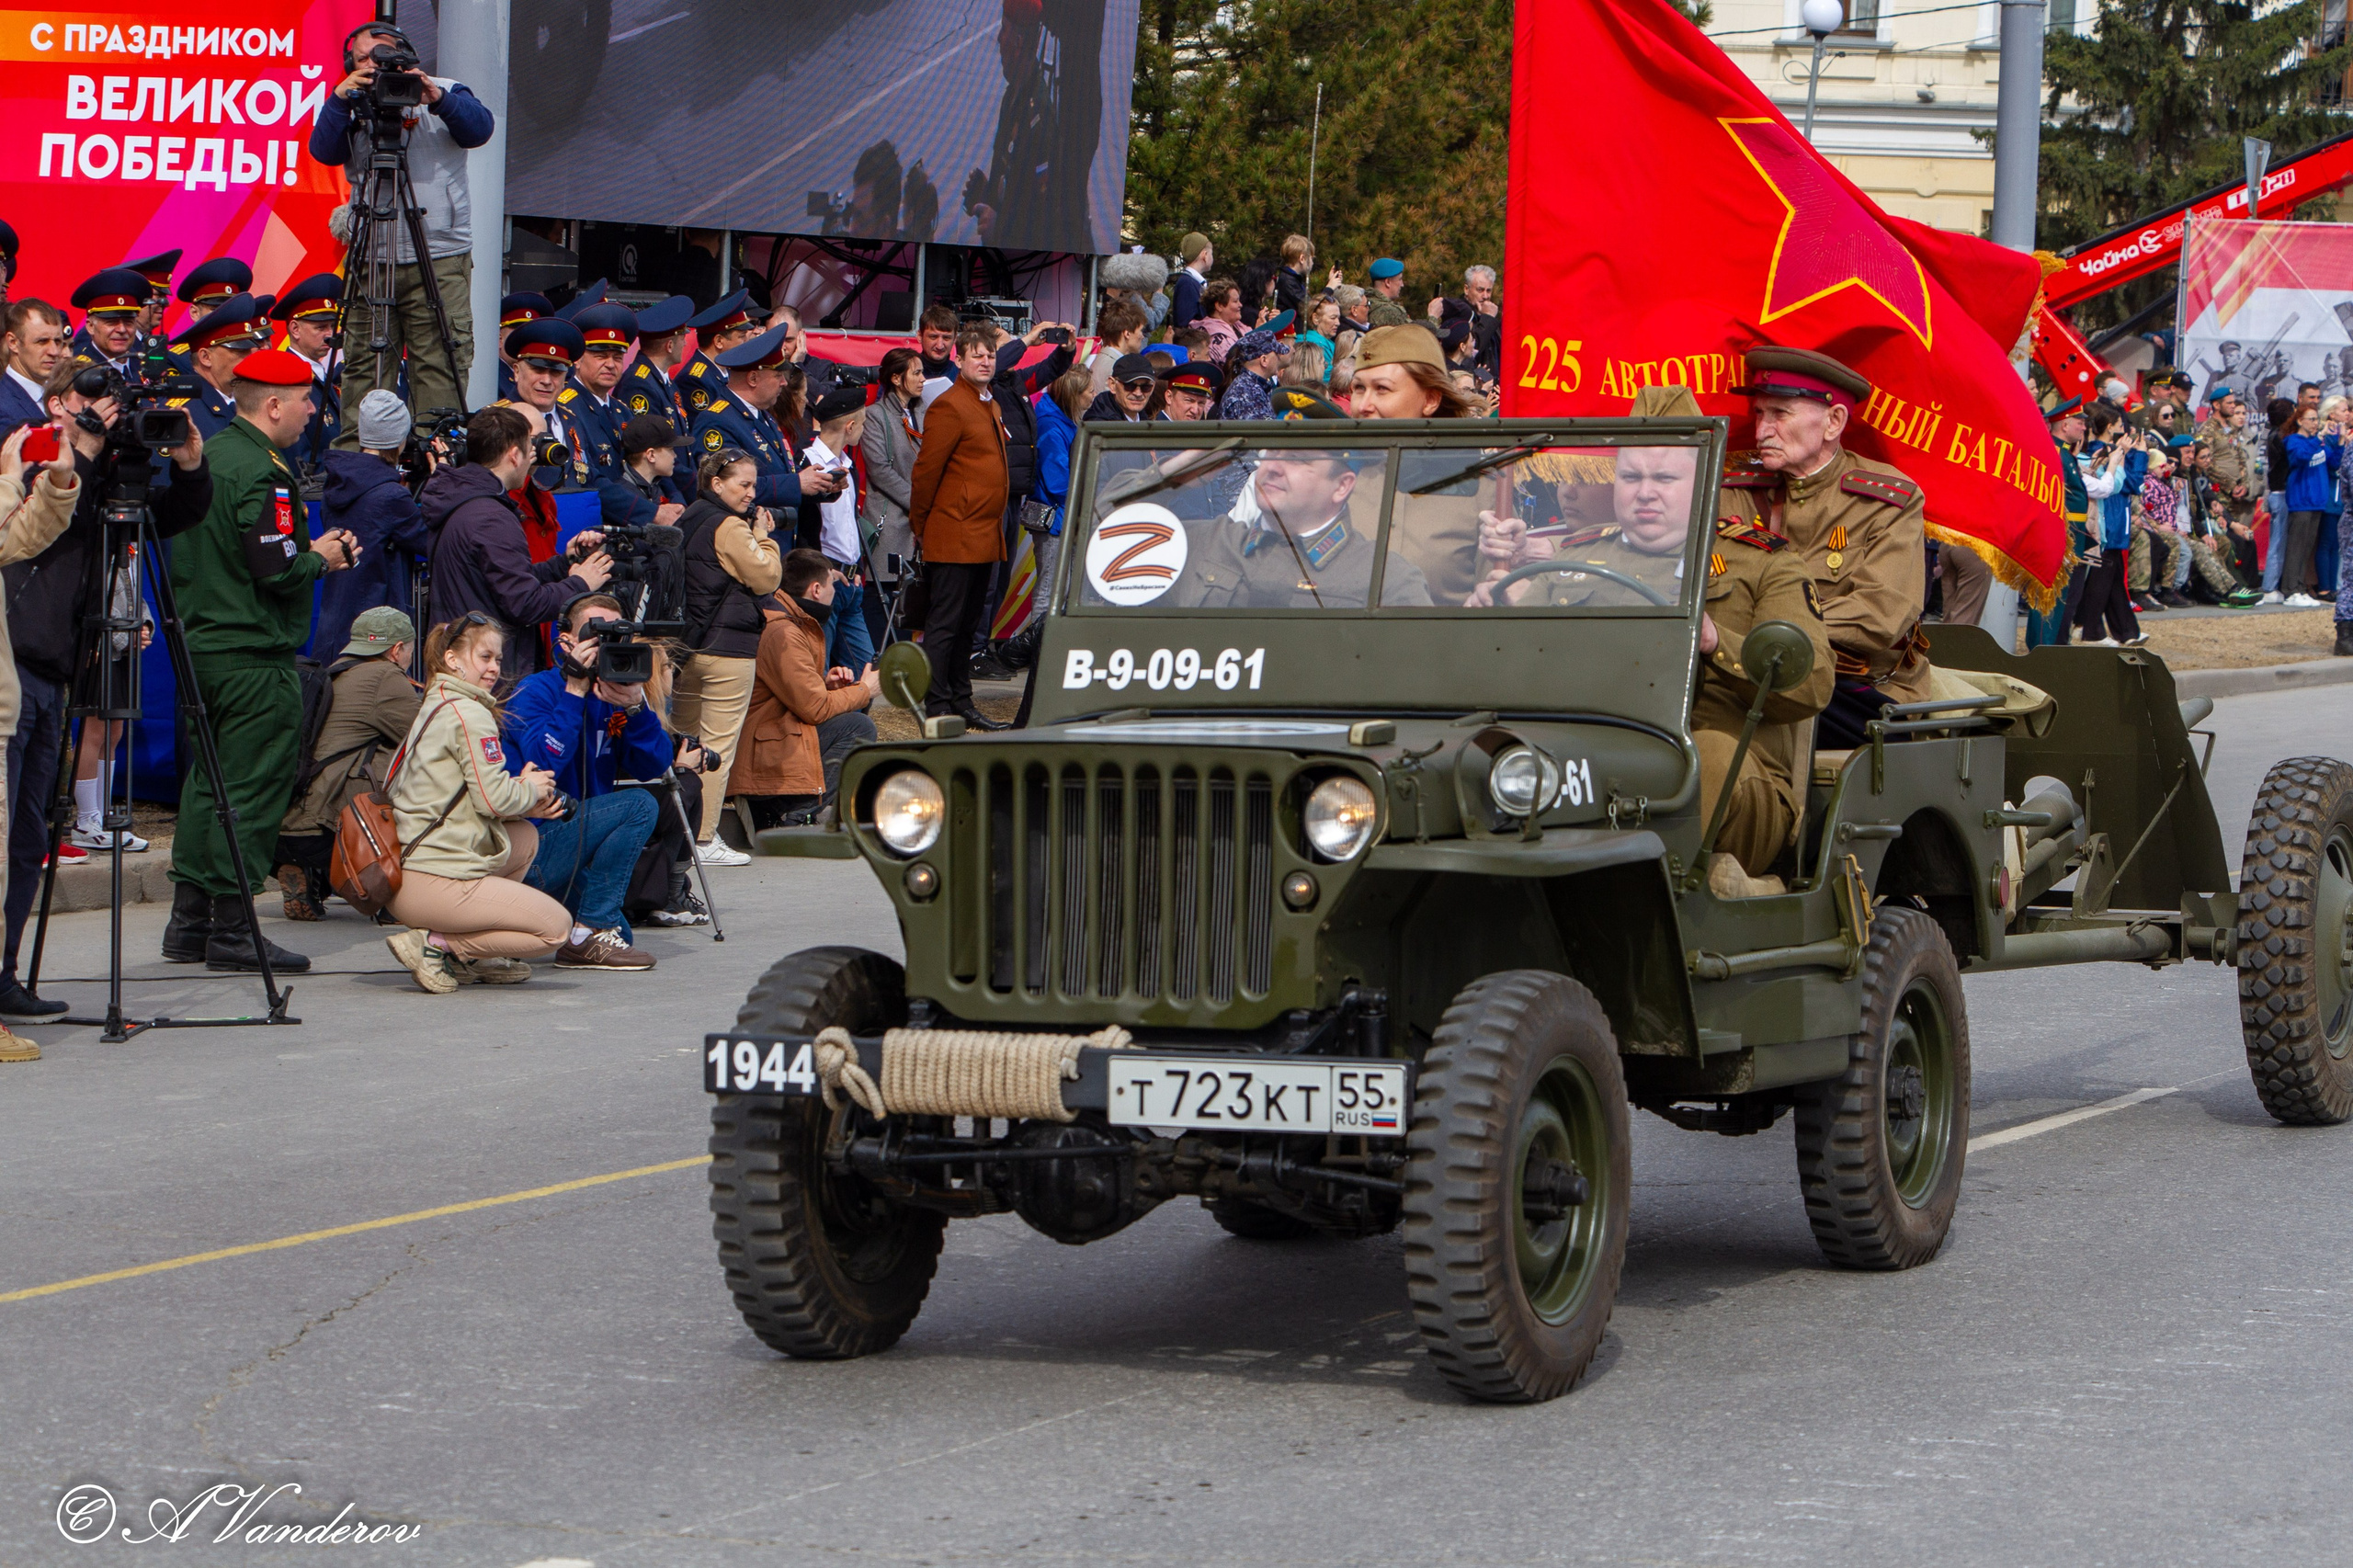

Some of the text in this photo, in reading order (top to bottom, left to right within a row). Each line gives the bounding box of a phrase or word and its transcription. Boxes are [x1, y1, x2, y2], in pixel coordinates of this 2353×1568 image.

[29, 23, 294, 59] С ПРАЗДНИКОМ
[66, 65, 326, 127] ВЕЛИКОЙ
[39, 132, 300, 192] ПОБЕДЫ!
[1518, 334, 1583, 393] 225
[708, 1039, 816, 1094] 1944
[1338, 1073, 1385, 1110] 55
[1336, 1111, 1370, 1127] RUS
